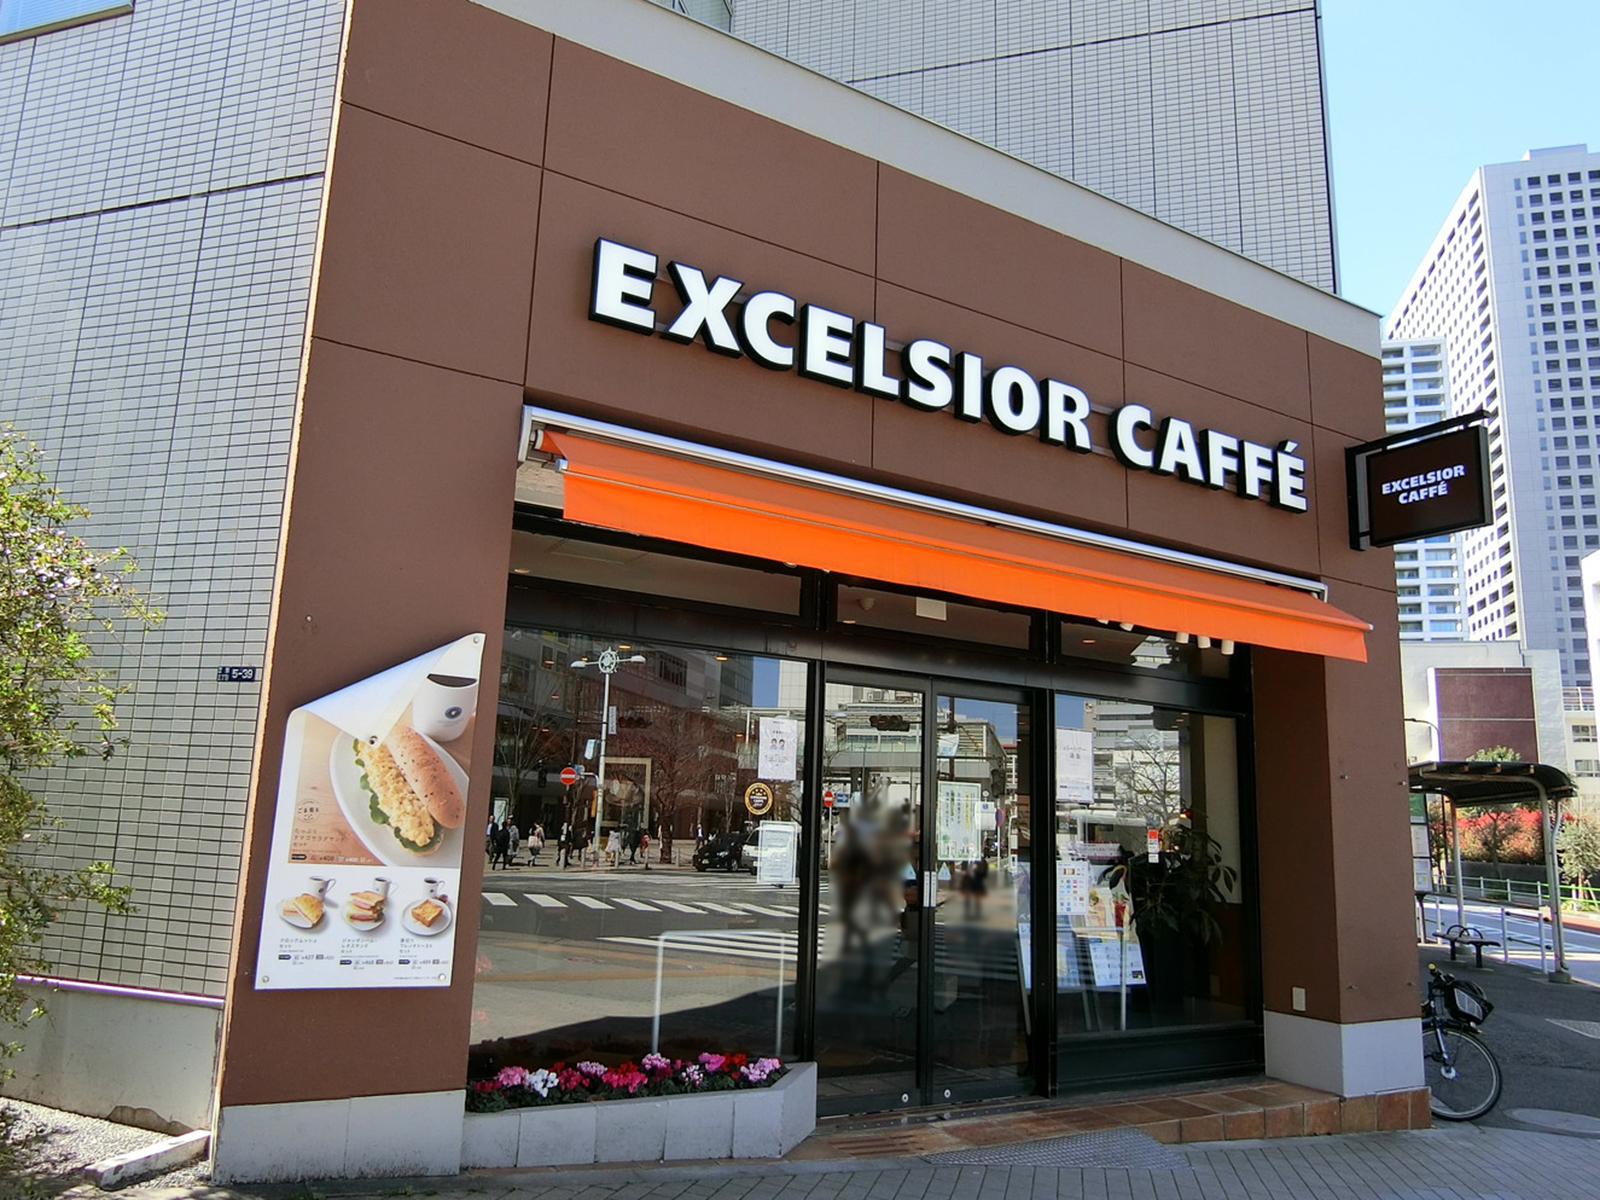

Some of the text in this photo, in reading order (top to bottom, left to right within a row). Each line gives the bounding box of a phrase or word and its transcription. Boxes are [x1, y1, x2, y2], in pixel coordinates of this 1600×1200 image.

[589, 237, 1308, 513] EXCELSIOR CAFFÉ
[1381, 464, 1466, 495] EXCELSIOR
[1398, 480, 1448, 504] CAFFÉ
[231, 668, 253, 679] 5-39
